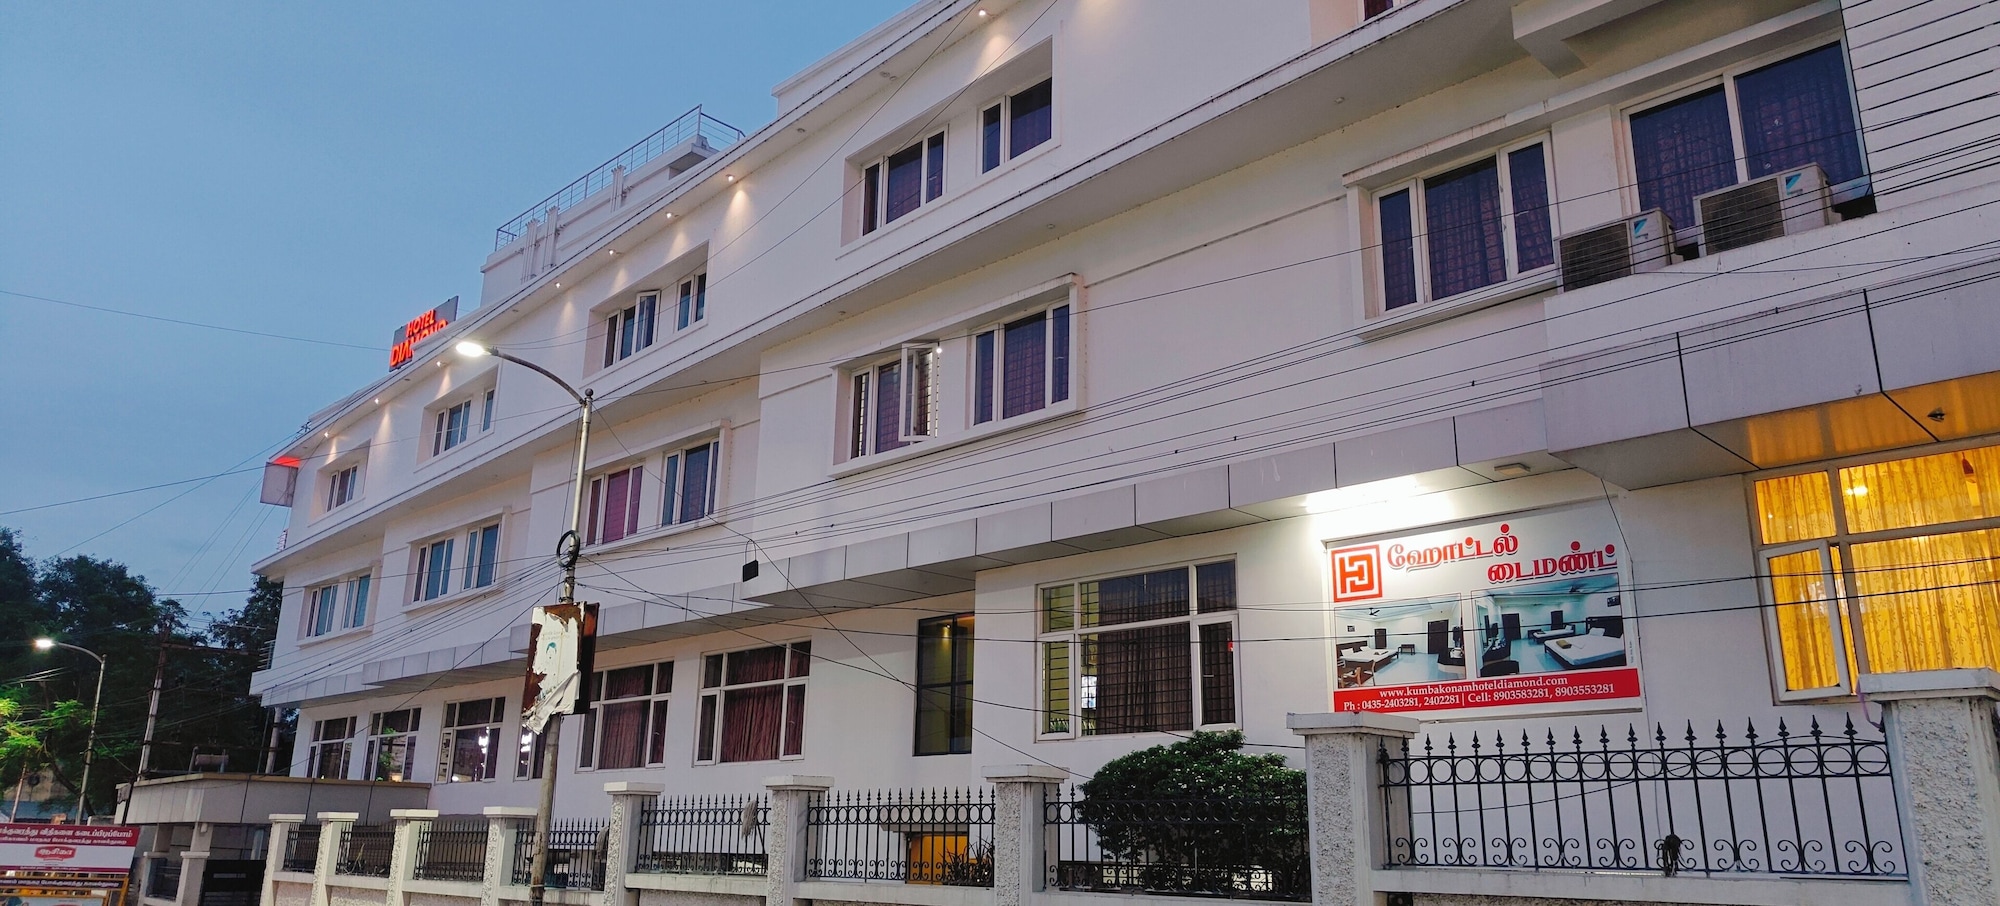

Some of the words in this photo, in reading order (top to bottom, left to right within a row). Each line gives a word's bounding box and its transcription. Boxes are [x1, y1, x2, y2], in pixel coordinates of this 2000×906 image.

[406, 309, 435, 337] HOTEL
[1387, 523, 1519, 572] ஹோட்டல்
[1488, 541, 1618, 584] டைமண்ட்
[1343, 701, 1356, 711] Ph
[1362, 697, 1422, 710] 0435-2403281,
[1424, 694, 1460, 706] 2402281
[1468, 692, 1493, 704] Cell:
[1493, 687, 1553, 701] 8903583281,
[1554, 683, 1615, 698] 8903553281
[1379, 676, 1568, 698] www.kumbakonamhoteldiamond.com
